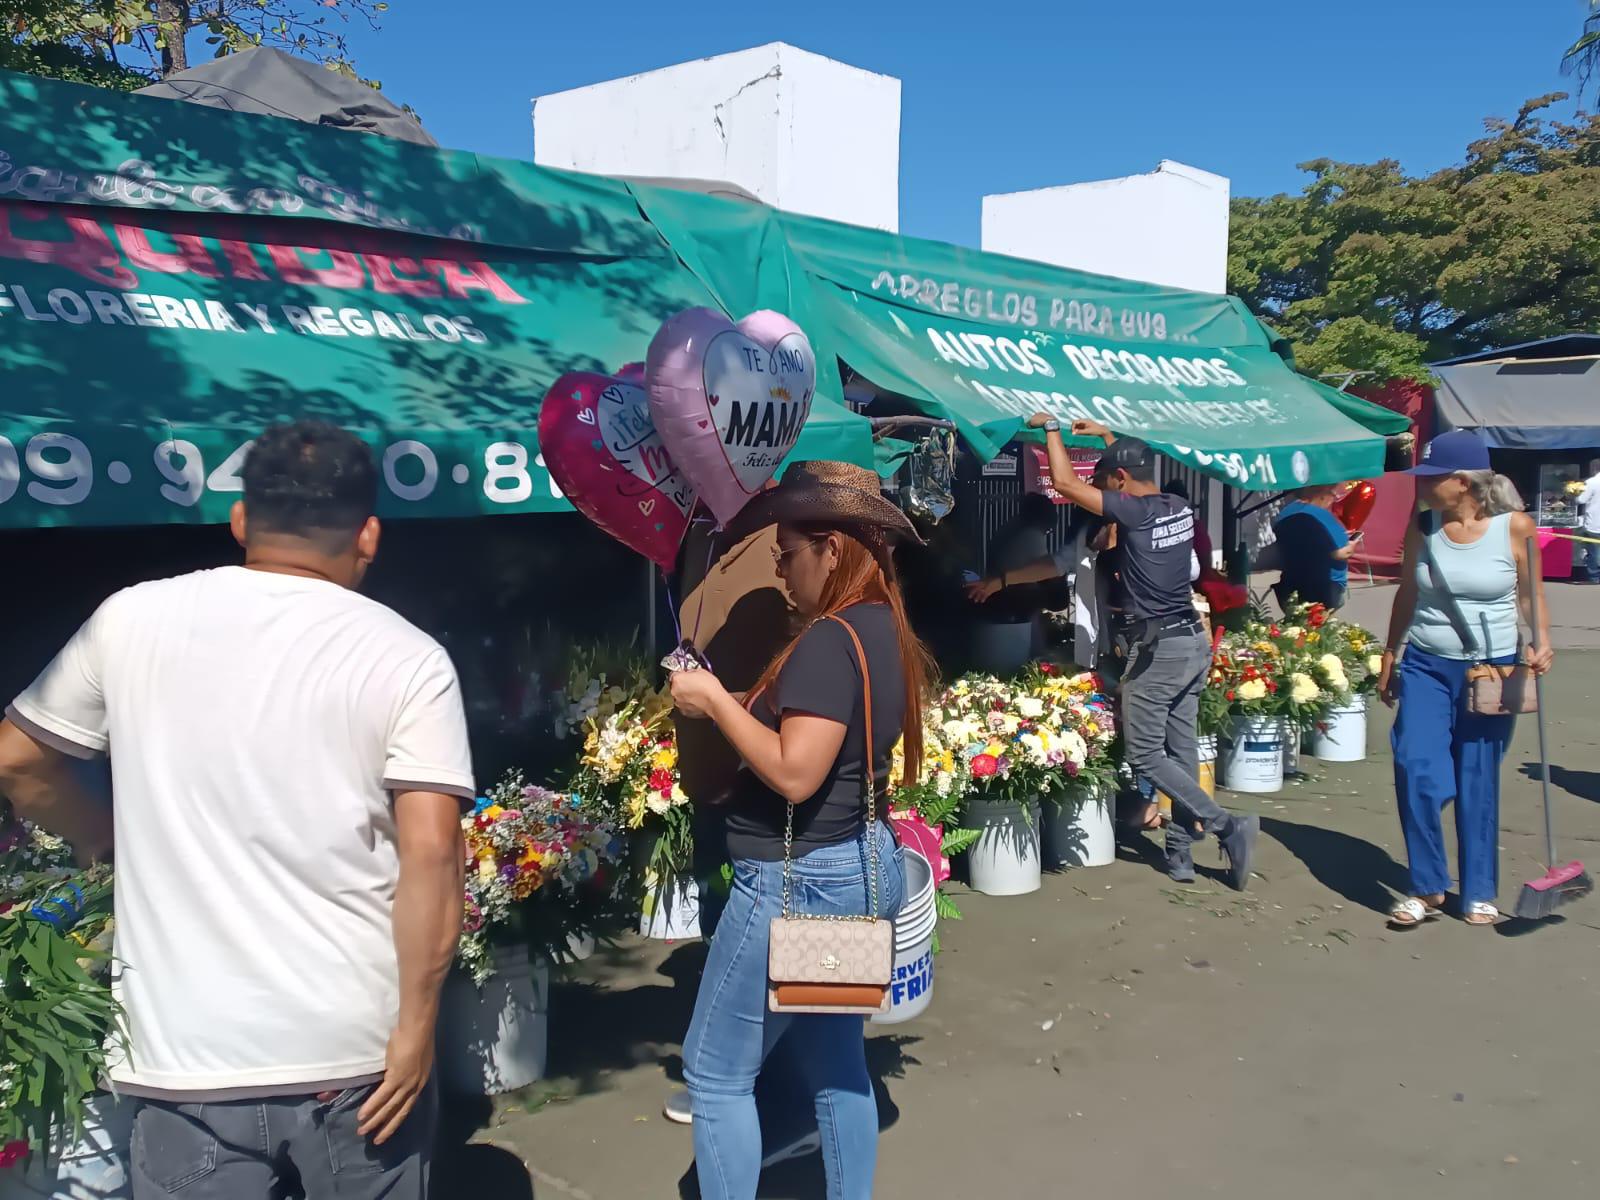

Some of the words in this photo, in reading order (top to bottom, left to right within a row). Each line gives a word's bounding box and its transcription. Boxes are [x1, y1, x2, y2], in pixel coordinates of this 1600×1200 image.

[237, 302, 277, 334] Y
[281, 303, 487, 343] REGALOS
[1050, 298, 1114, 337] PARA
[742, 346, 764, 372] TE
[778, 349, 804, 373] AMO
[926, 327, 1056, 378] AUTOS
[1062, 344, 1248, 388] DECORADOS
